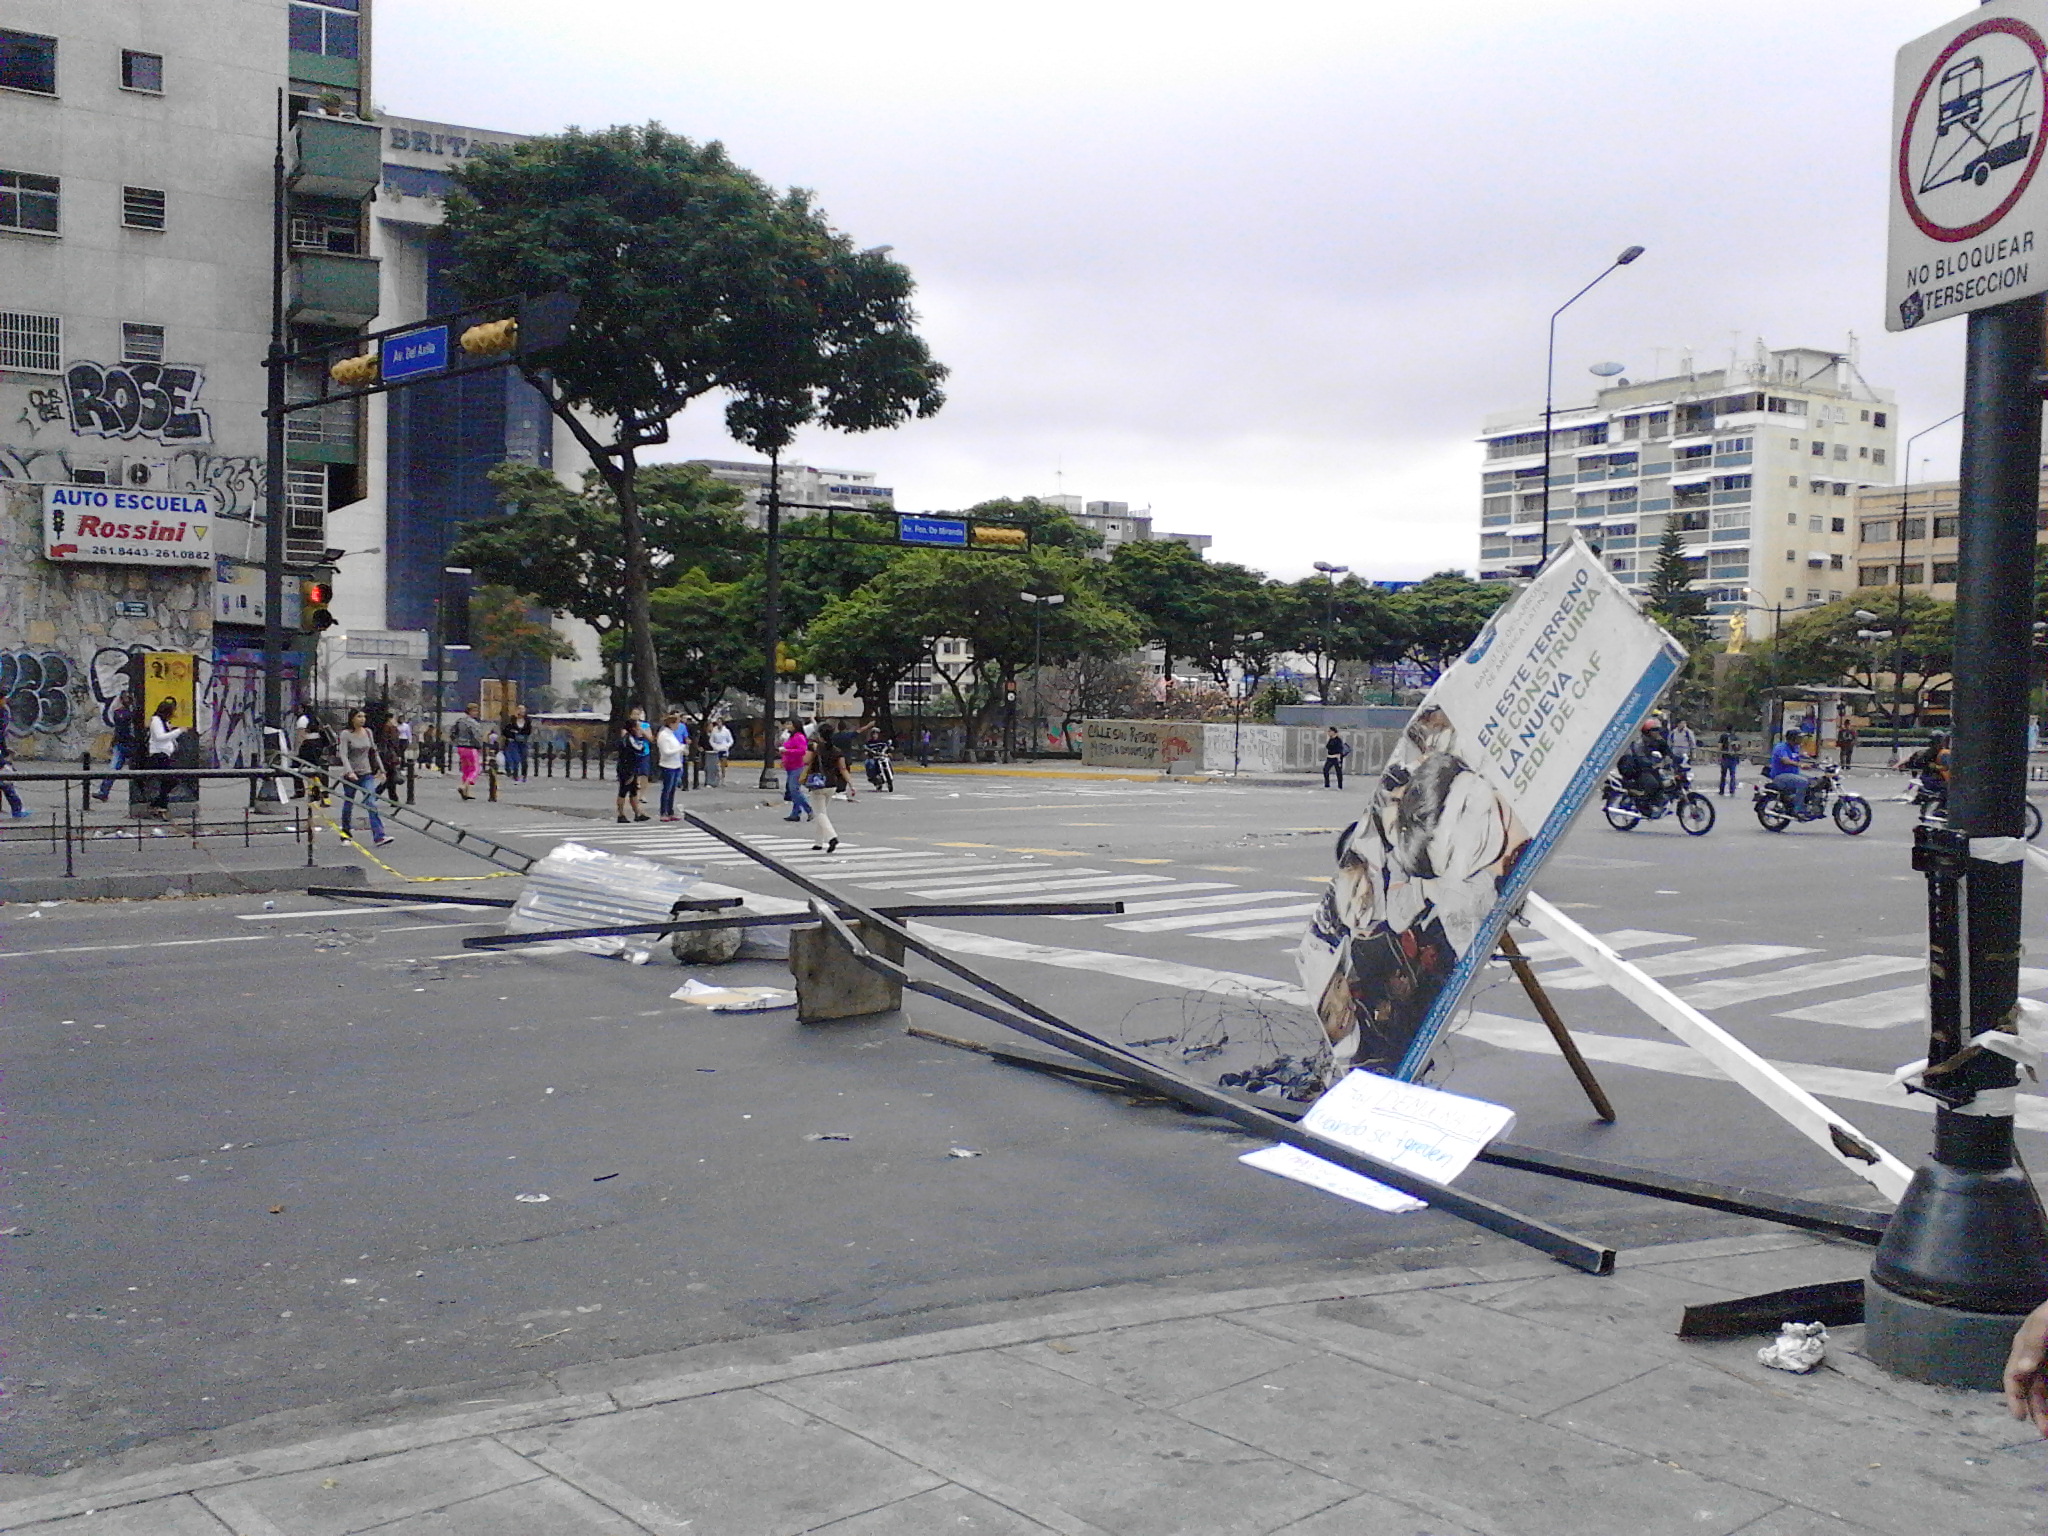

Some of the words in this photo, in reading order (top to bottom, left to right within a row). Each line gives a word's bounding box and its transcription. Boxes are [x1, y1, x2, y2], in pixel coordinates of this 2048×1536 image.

[1907, 264, 1930, 289] NO
[1935, 230, 2035, 280] BLOQUEAR
[1919, 262, 2029, 312] TERSECCION
[64, 360, 214, 447] ROSE
[52, 489, 108, 507] AUTO
[115, 493, 208, 514] ESCUELA
[76, 514, 187, 542] Rossini
[1476, 713, 1499, 747] EN
[1494, 663, 1531, 717] ESTE
[1527, 567, 1590, 663] TERRENO
[1487, 725, 1513, 762] SE
[1507, 588, 1603, 730] CONSTRUIRA
[1283, 728, 1384, 776] LIBETAD
[1499, 748, 1525, 779] LA
[1518, 672, 1574, 747] NUEVA
[1512, 731, 1555, 795] SEDE
[1549, 698, 1574, 735] DE
[1570, 649, 1600, 700] CAF
